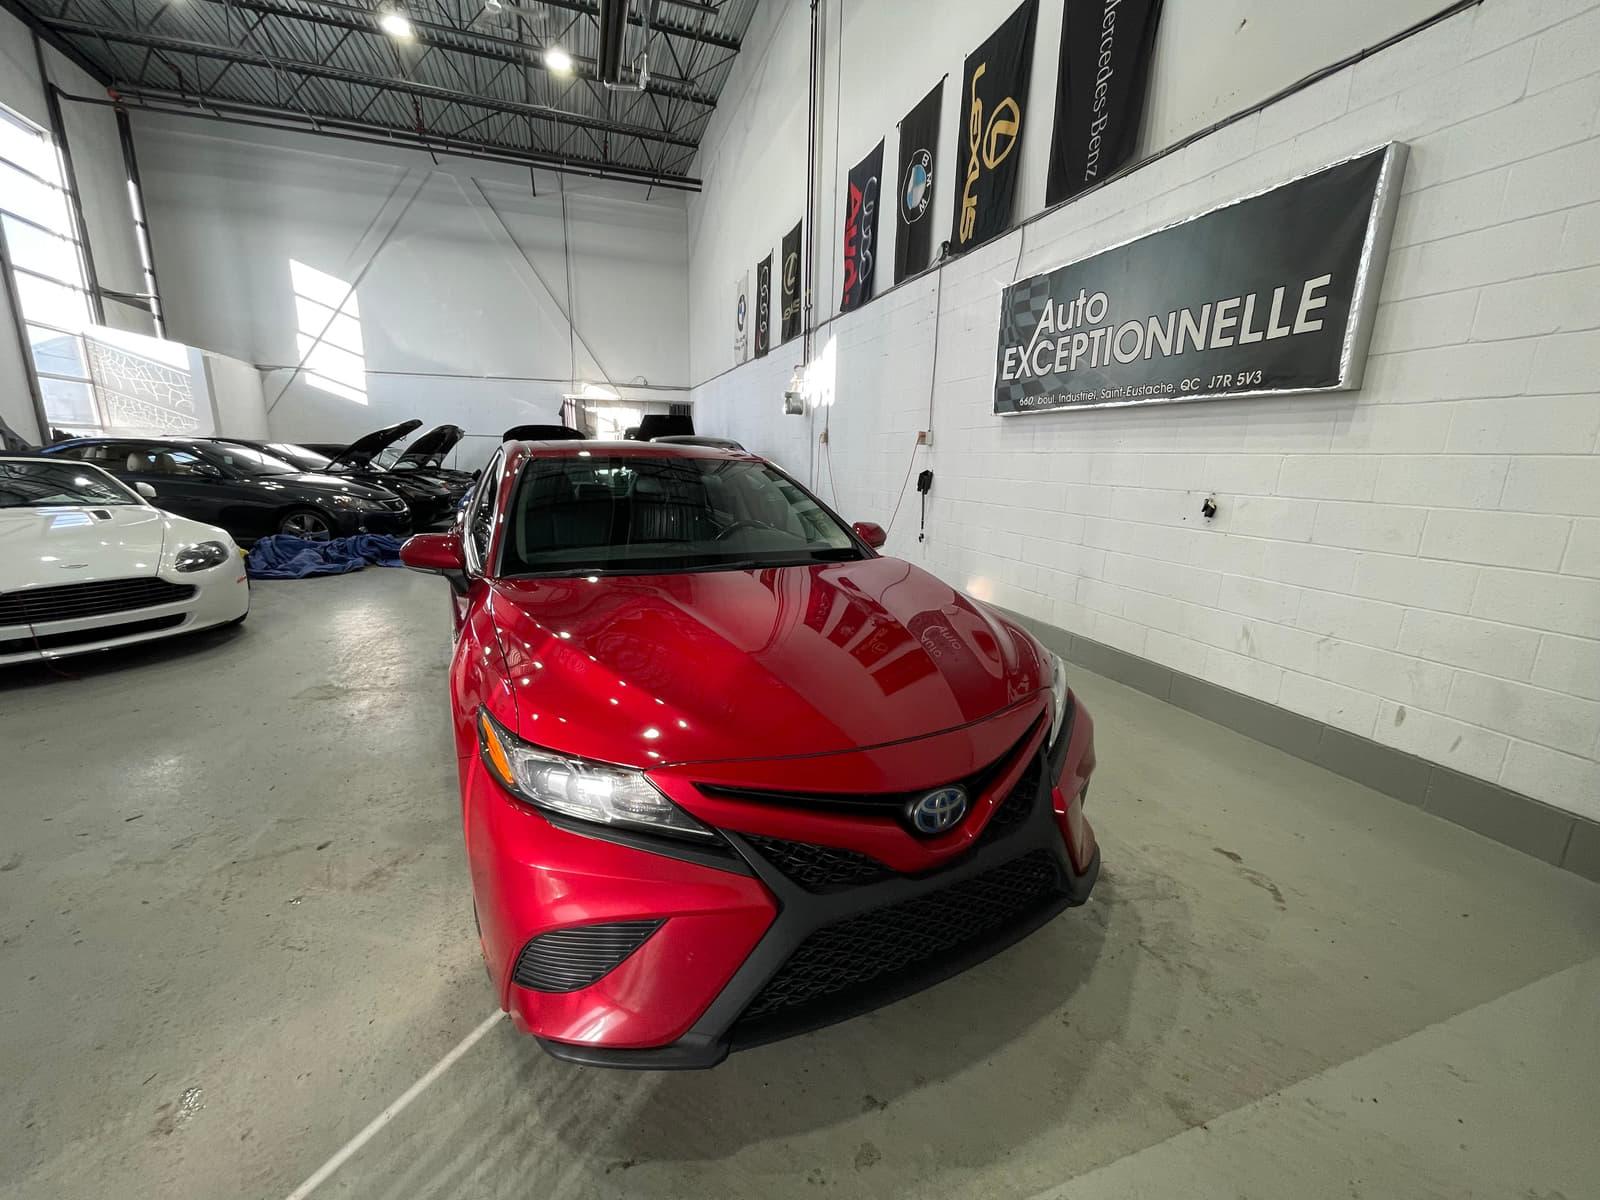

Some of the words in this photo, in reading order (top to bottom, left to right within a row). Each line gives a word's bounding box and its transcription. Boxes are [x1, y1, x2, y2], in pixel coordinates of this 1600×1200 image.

[960, 62, 986, 244] LEXUS
[1002, 273, 1332, 381] EXCEPTIONNELLE
[1037, 288, 1109, 334] Auto
[1101, 381, 1176, 399] Saint-Eustache,
[1180, 377, 1201, 391] QC
[1207, 374, 1233, 389] J7R
[1236, 370, 1262, 386] 5V3
